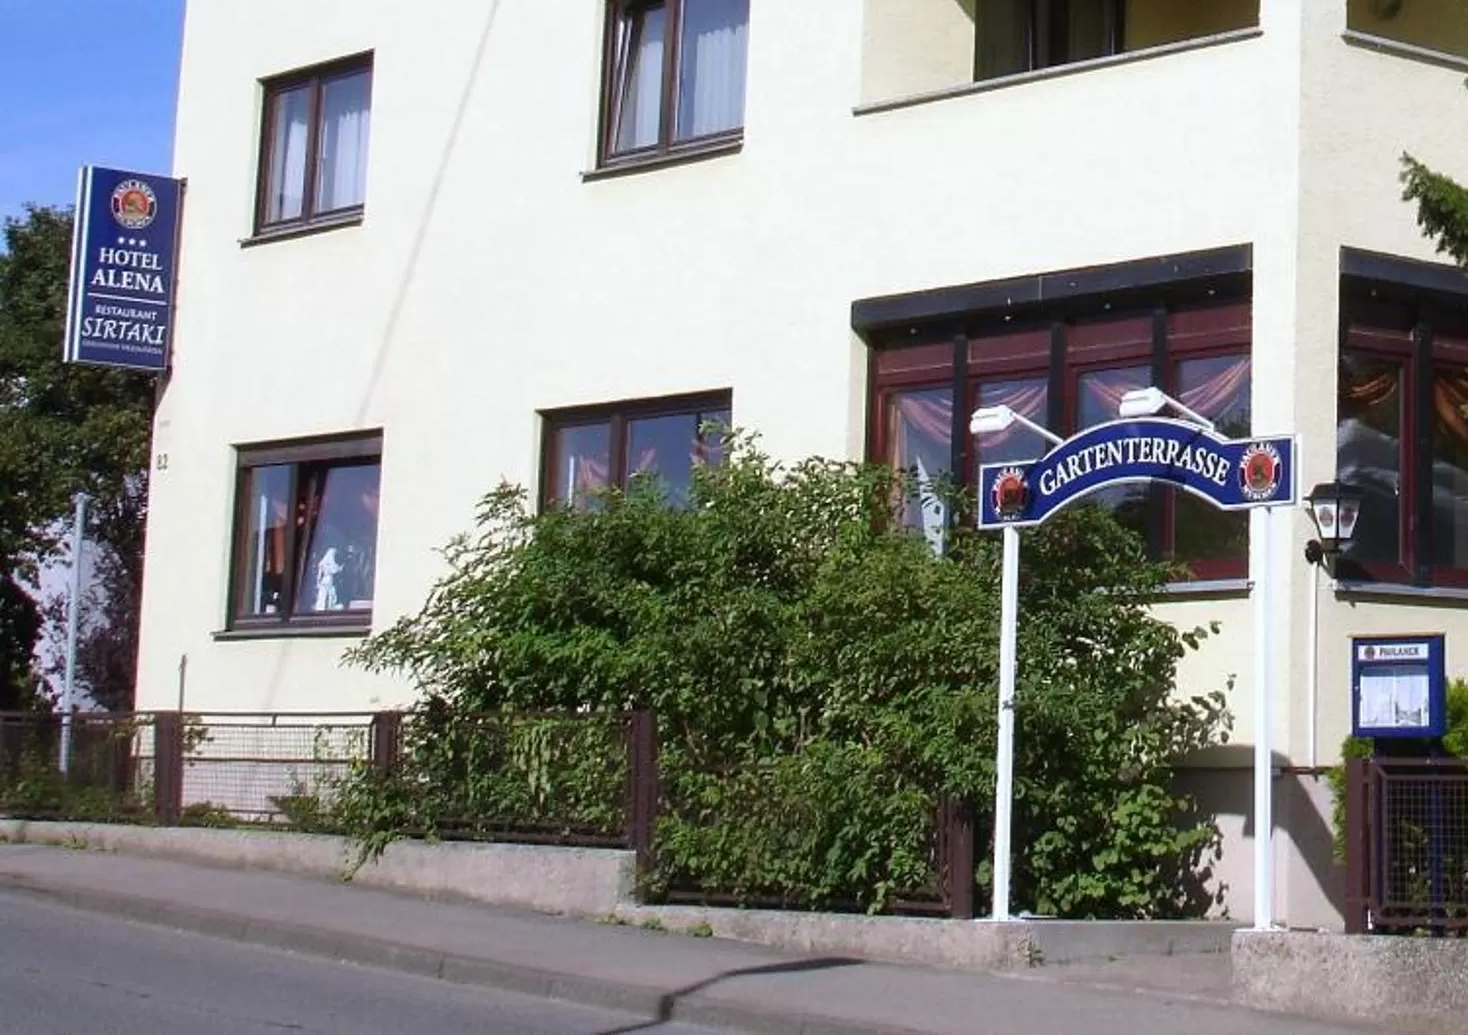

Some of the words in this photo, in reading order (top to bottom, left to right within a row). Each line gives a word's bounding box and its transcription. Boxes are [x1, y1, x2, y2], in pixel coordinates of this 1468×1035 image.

[100, 247, 163, 270] HOTEL
[91, 269, 165, 294] ALENA
[95, 305, 157, 321] RESTAURANT
[81, 316, 166, 344] SIRTAKI
[1039, 437, 1231, 495] GARTENTERRASSE
